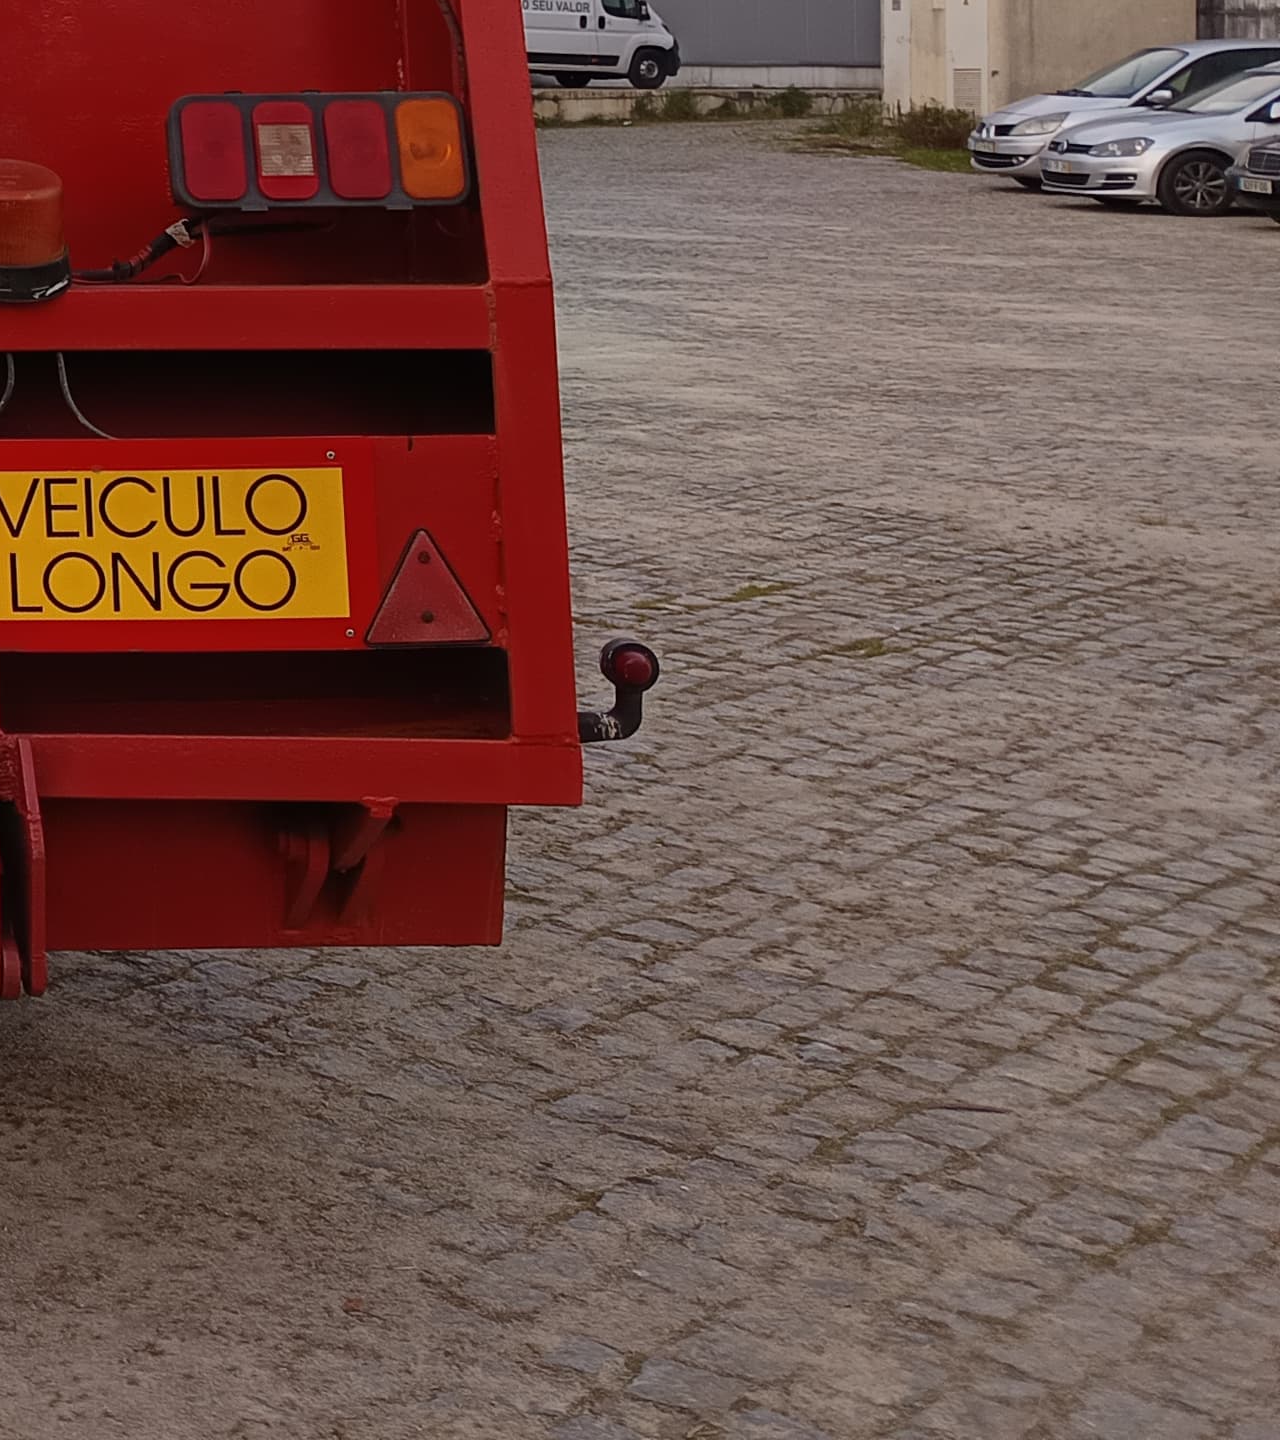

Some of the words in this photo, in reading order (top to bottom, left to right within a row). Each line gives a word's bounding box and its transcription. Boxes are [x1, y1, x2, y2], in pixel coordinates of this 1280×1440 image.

[522, 0, 529, 10] O
[532, 0, 553, 11] SEU
[556, 1, 590, 13] VALOR
[9, 549, 297, 613] LONGO
